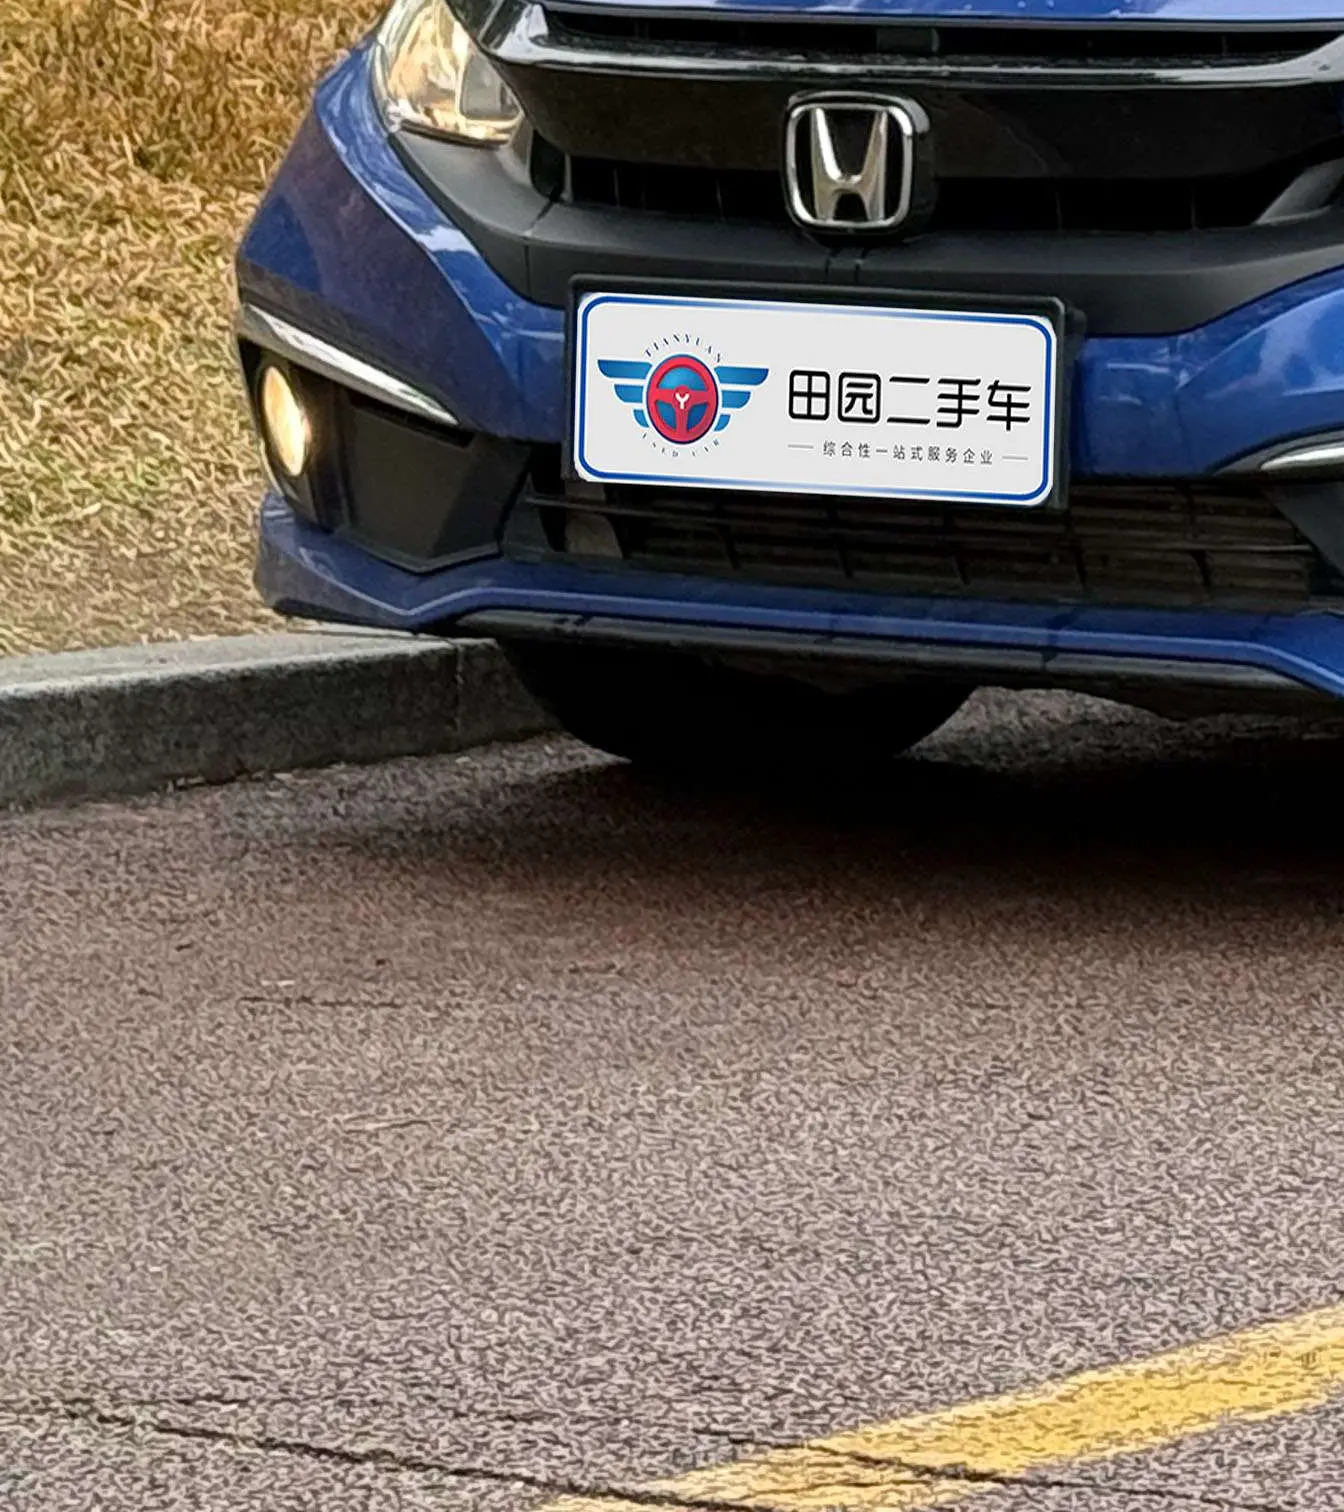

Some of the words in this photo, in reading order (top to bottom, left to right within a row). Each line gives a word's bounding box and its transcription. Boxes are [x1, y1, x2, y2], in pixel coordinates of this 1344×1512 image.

[674, 392, 690, 410] Y
[788, 369, 1032, 431] 田园二手车
[822, 439, 994, 465] 综合性一站式服务企业
